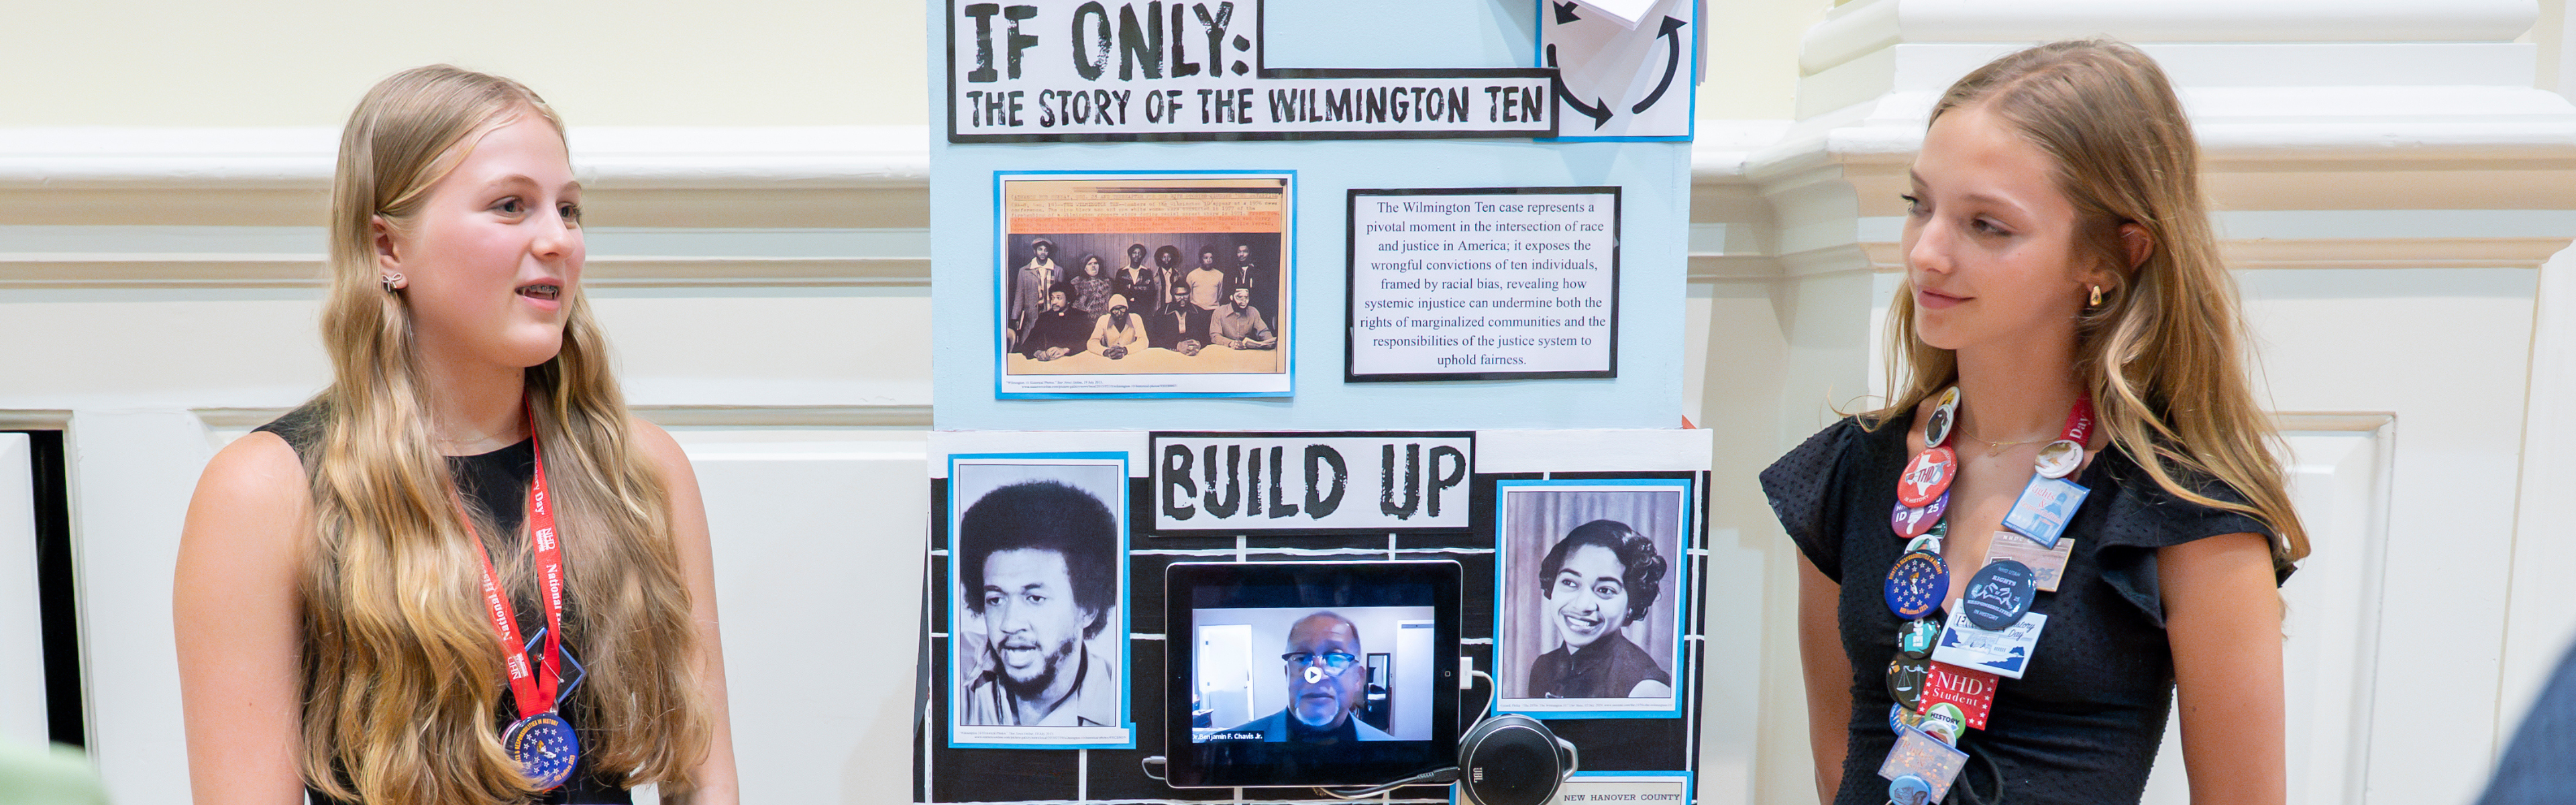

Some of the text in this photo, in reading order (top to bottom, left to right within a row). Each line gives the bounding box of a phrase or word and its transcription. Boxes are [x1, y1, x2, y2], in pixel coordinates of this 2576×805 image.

[965, 1, 1250, 83] IF ONLY:
[966, 85, 1543, 128] THE STORY OF THE WILMINGTON TEN
[1377, 201, 1595, 215] The Wilmington Ten case represents a
[1366, 220, 1604, 235] pivotal moment in the intersection of race
[1378, 239, 1591, 254] and justice in America; it exposes the
[1371, 258, 1598, 273] wrongful convictions of ten individuals,
[1381, 277, 1587, 292] framed by racial bias, revealing how
[1364, 297, 1602, 311] systemic injustice can undermine both the
[1360, 315, 1606, 331] rights of marginalized communities and the
[1373, 335, 1592, 350] responsibilities of the justice system to
[1438, 354, 1526, 368] uphold fairness.
[2069, 417, 2092, 440] Day
[1162, 443, 1466, 521] BUILD UP
[2030, 482, 2056, 502] Rights
[1926, 503, 1939, 515] 25
[2038, 499, 2047, 508] &
[1895, 511, 1908, 523] ID
[546, 563, 562, 610] National
[1992, 575, 2017, 586] RIGHTS
[1967, 599, 2013, 617] RESPONSIBILITIES
[1979, 610, 1999, 621] HISTORY
[488, 594, 513, 641] National
[2012, 621, 2036, 633] istory
[2008, 629, 2025, 641] Day
[1935, 670, 1984, 696] NHD
[1933, 687, 1978, 706] Student
[1930, 712, 1961, 726] HISTORY
[1472, 767, 1483, 784] JBL
